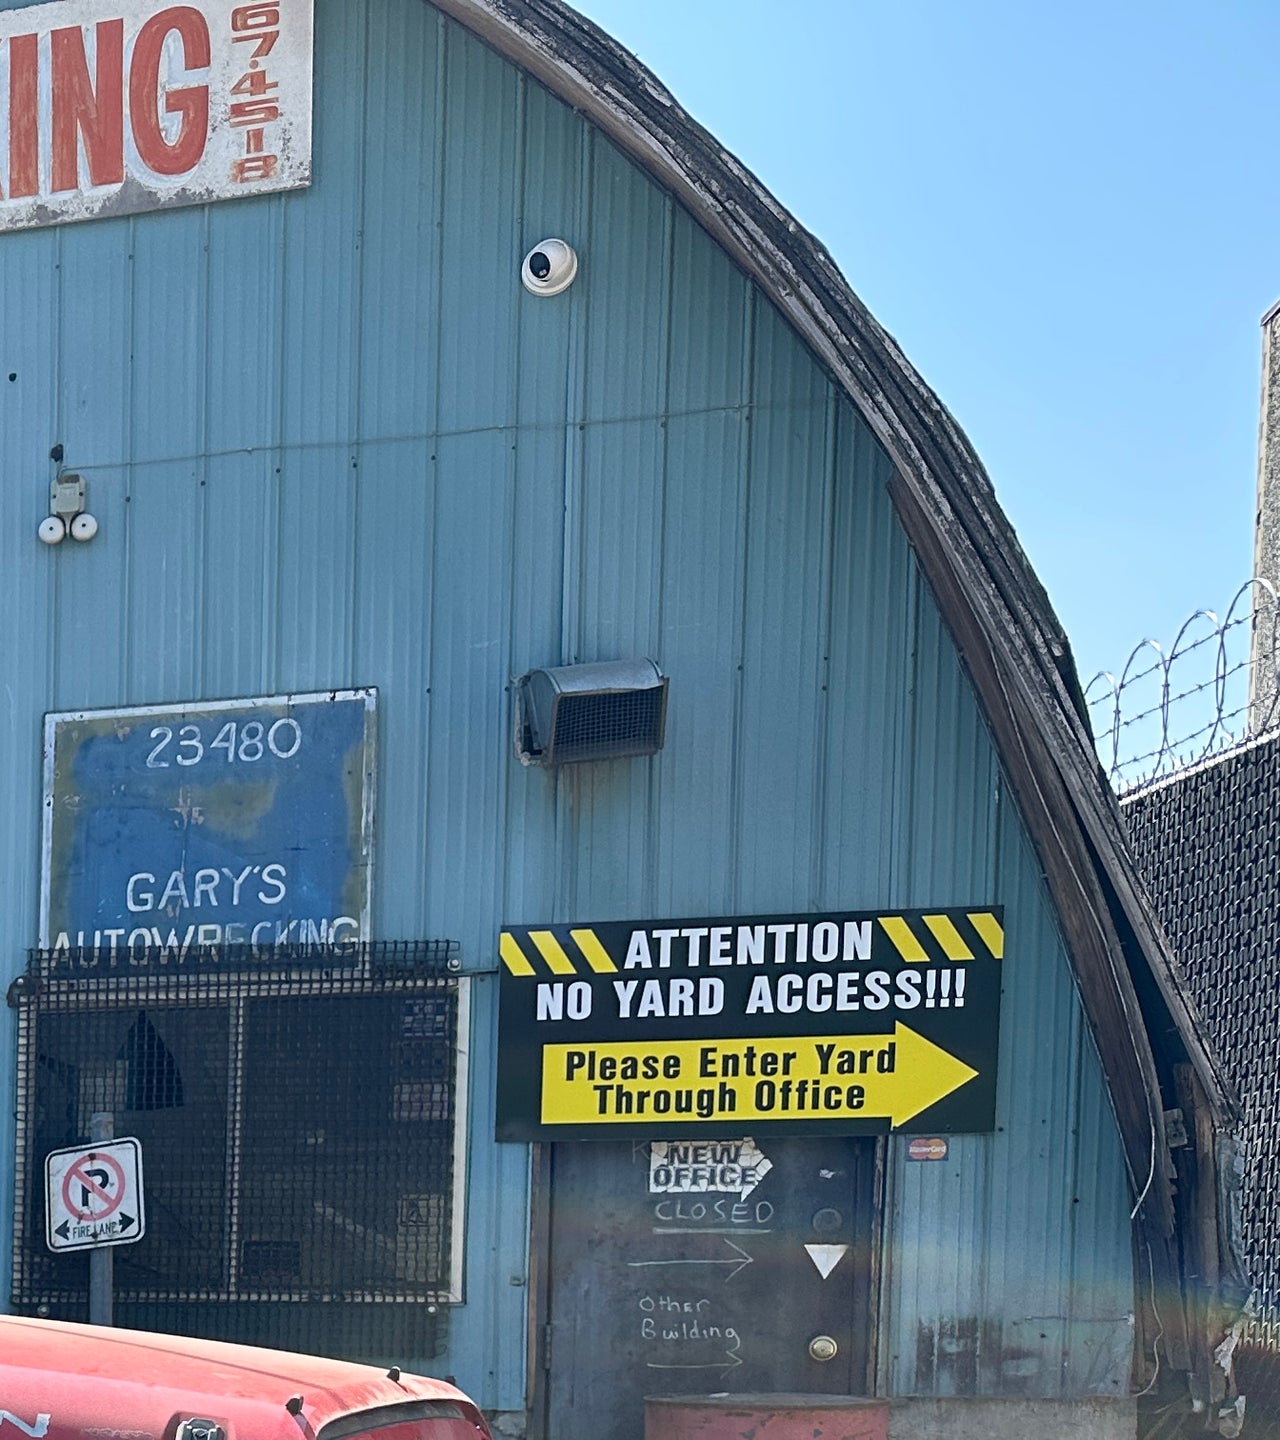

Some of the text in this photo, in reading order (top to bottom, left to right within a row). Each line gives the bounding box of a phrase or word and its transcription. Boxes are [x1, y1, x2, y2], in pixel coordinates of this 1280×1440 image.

[144, 717, 302, 769] 23480
[126, 863, 288, 913] GARY'S
[624, 920, 873, 970] ATTENTION
[536, 969, 966, 1021] NO YARD ACCESS!!!
[565, 1042, 896, 1081] Please Enter Yard
[593, 1079, 865, 1118] Through Office
[668, 1145, 739, 1164] NEW
[653, 1166, 757, 1186] OFFICE
[72, 1224, 91, 1239] FIRE
[654, 1200, 775, 1224] CLOSED
[641, 1318, 741, 1351] Building
